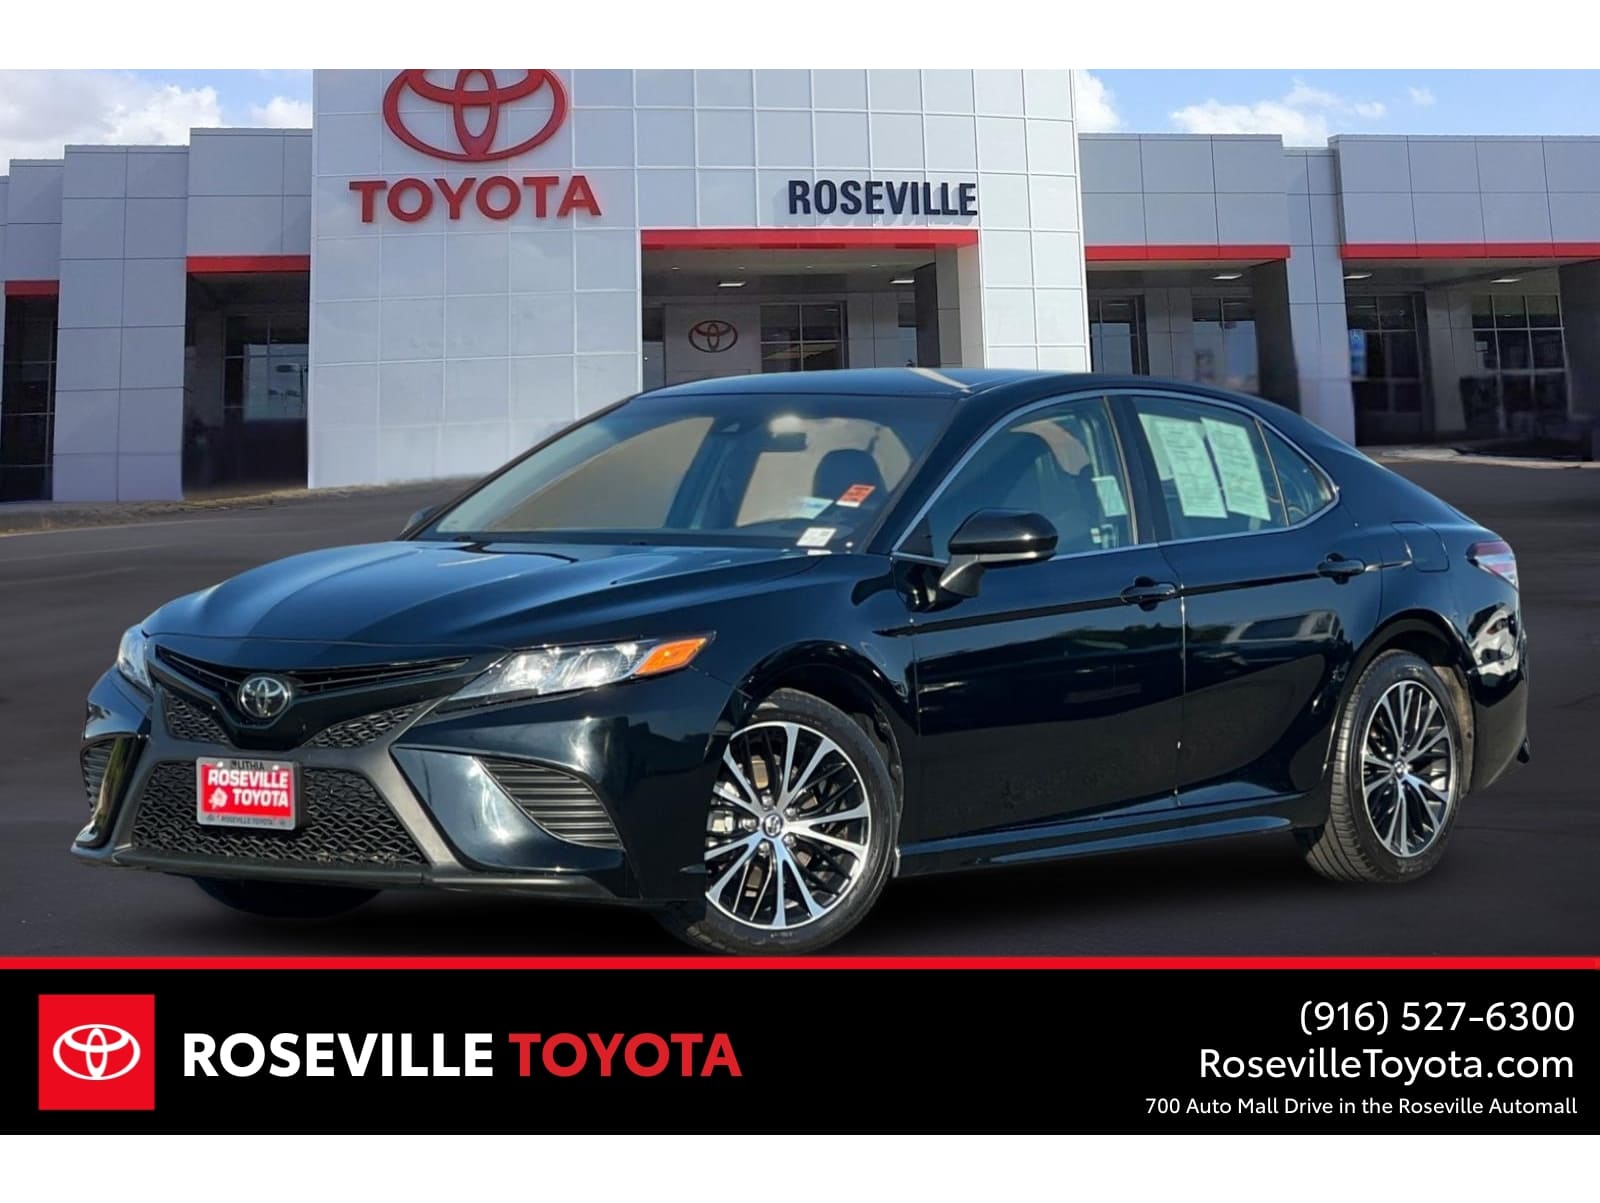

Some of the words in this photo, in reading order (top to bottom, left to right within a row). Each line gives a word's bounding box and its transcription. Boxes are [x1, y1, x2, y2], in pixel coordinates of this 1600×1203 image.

[349, 175, 602, 223] TOYOTA
[788, 179, 979, 217] ROSEVILLE
[208, 769, 289, 788] ROSEVILLE
[232, 788, 289, 807] TOYOTA
